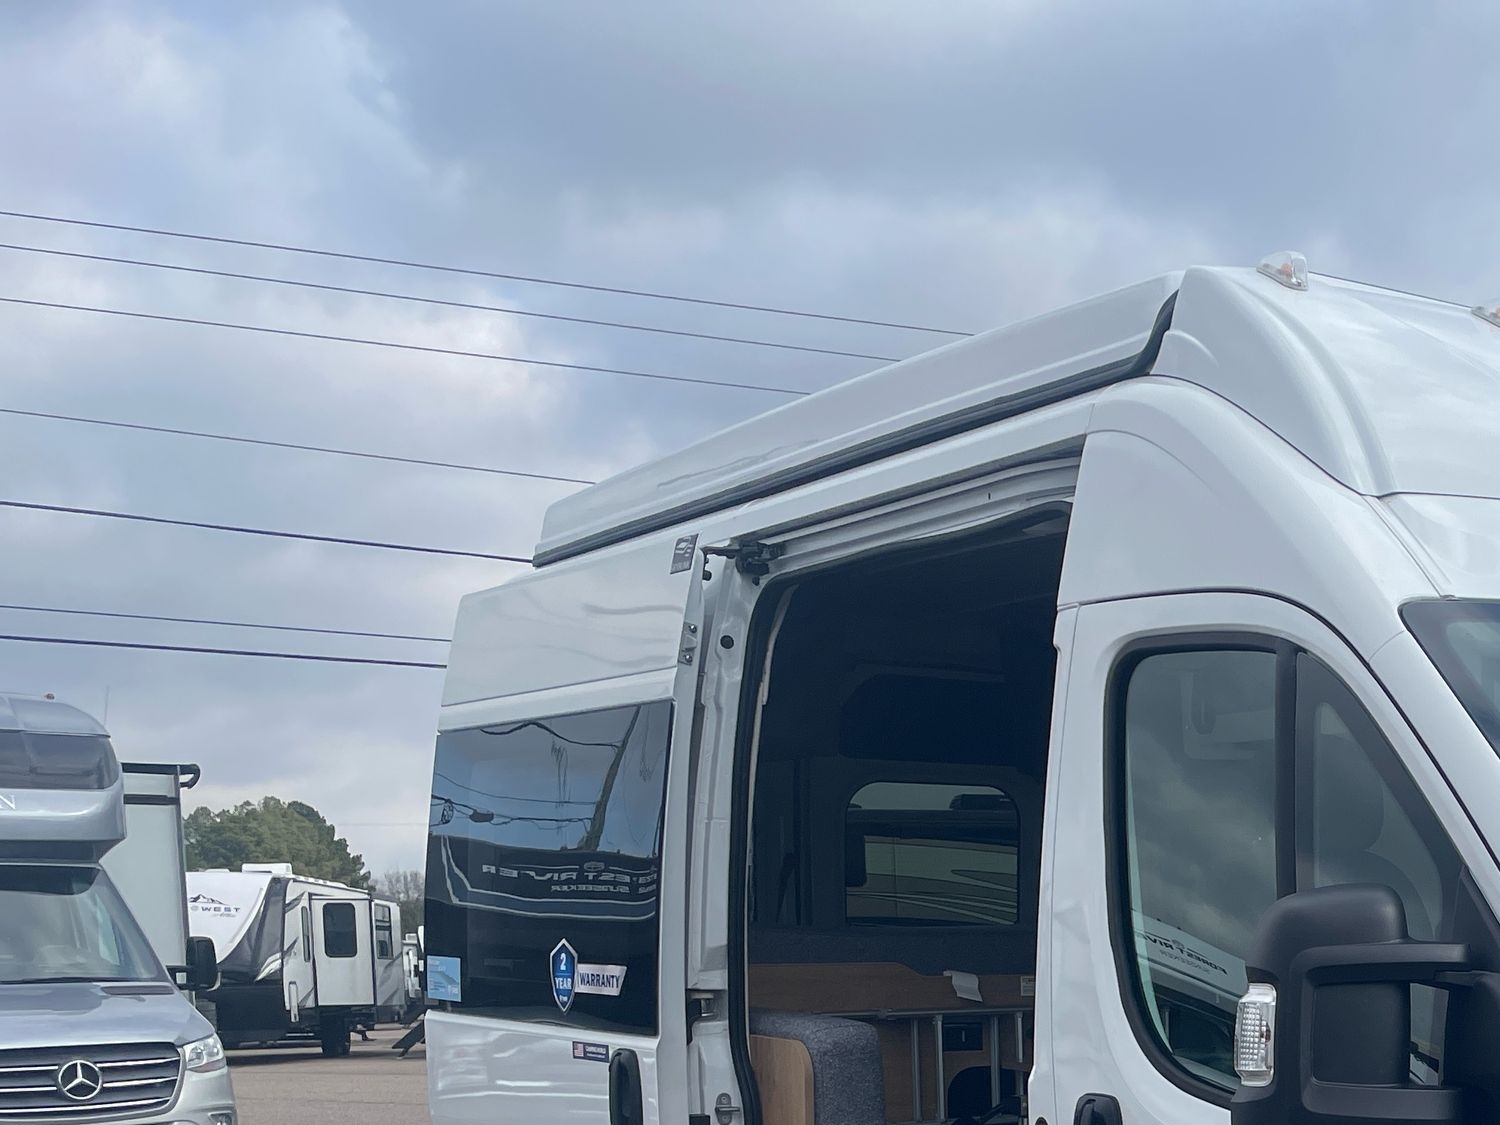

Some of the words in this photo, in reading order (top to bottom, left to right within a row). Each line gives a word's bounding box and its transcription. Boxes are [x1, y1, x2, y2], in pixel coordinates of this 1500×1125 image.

[560, 952, 567, 971] 2
[554, 976, 572, 990] YEAR
[579, 972, 621, 989] WARRANTY
